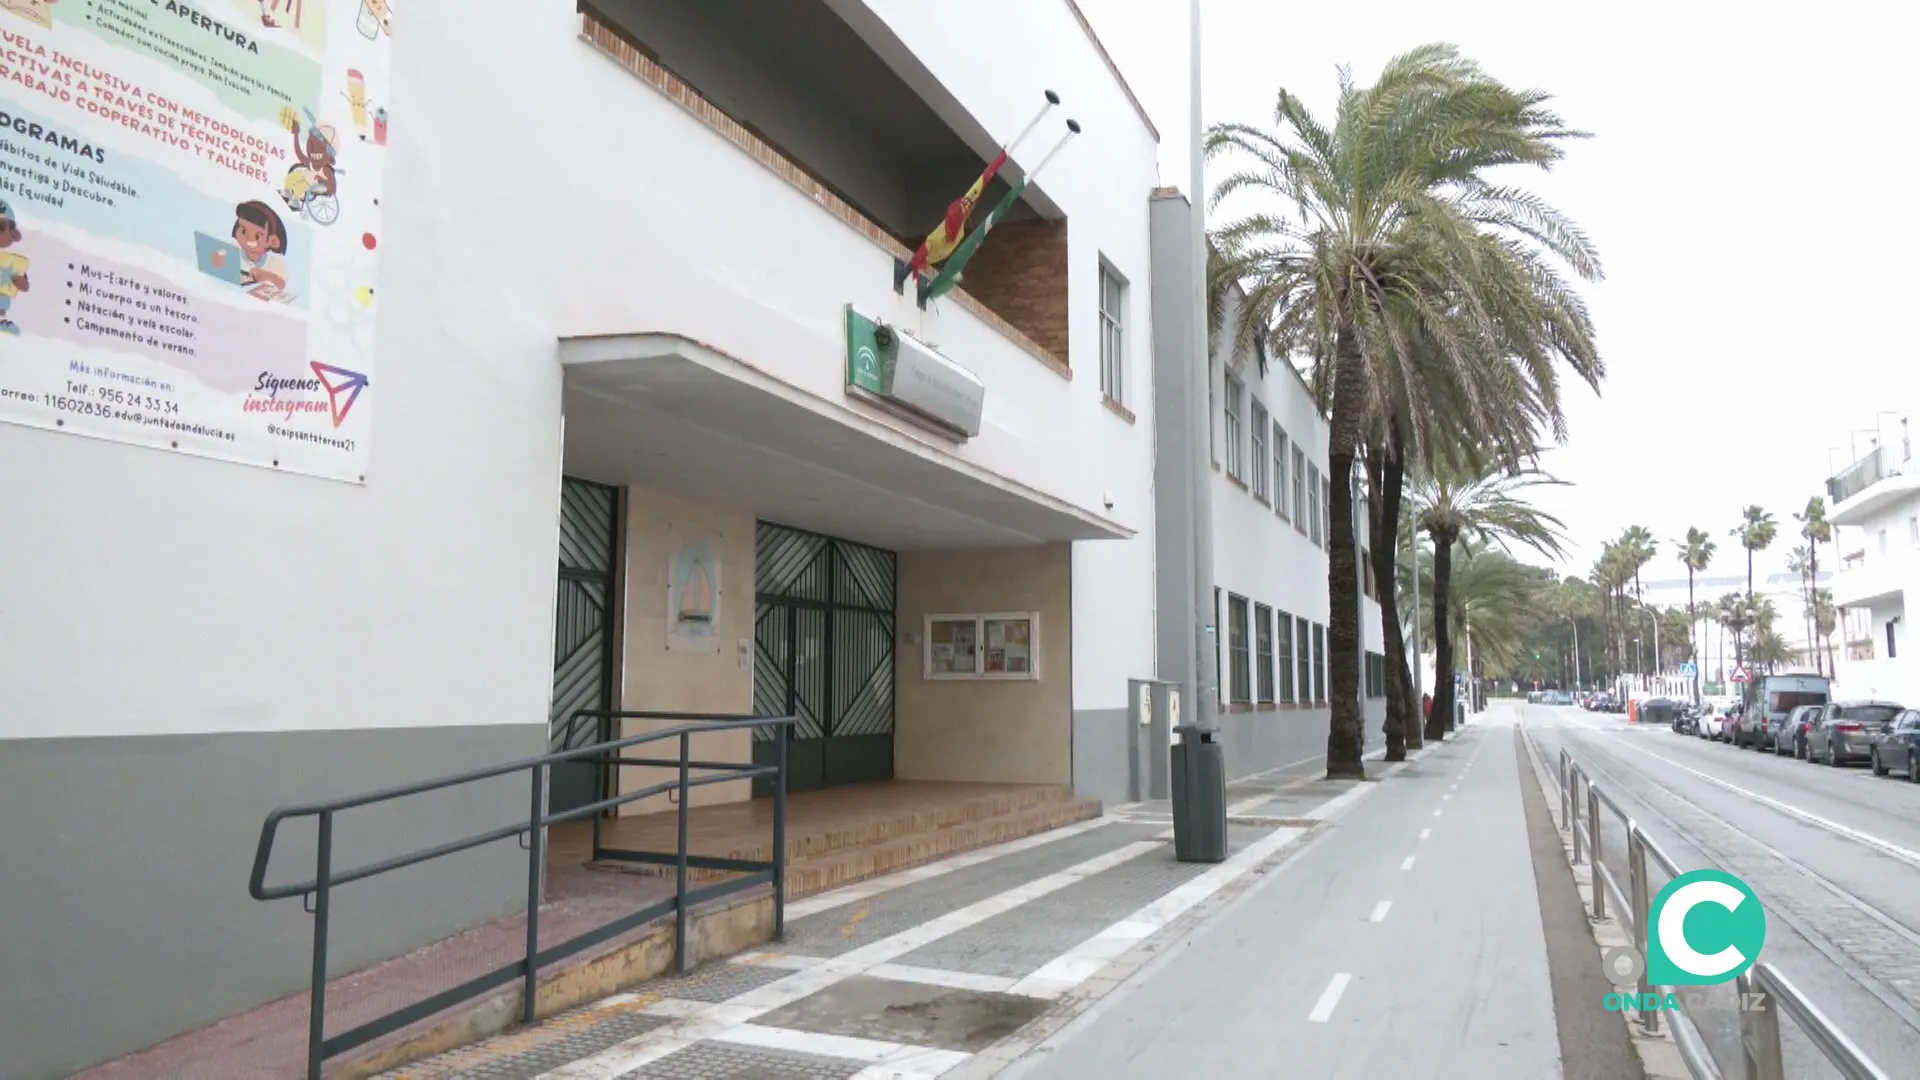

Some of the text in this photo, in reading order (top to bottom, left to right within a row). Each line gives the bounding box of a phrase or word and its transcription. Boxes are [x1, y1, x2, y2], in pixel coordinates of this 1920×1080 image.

[96, 17, 135, 40] Comedor
[137, 38, 152, 50] con
[165, 0, 258, 54] APERTURA
[52, 50, 142, 98] INCLUSIVA
[147, 92, 178, 114] CON
[77, 80, 88, 93] A
[158, 113, 175, 130] DE
[250, 152, 266, 167] DE
[76, 97, 189, 150] COOPERATIVO
[194, 143, 202, 157] Y
[207, 149, 271, 185] TALLERES.
[44, 156, 58, 169] de
[62, 161, 85, 179] Vida
[88, 171, 140, 199] Saludable.
[52, 179, 59, 190] y
[62, 179, 117, 208] Descubre.
[19, 183, 64, 208] Equidad
[79, 282, 200, 325] Mi cuerpo es un tesoro.
[144, 284, 150, 295] y
[152, 287, 190, 306] valores.
[77, 300, 198, 341] Natación y vela escolar.
[76, 317, 198, 358] Campamento de verano.
[69, 360, 175, 392] Más información en:
[254, 371, 320, 398] Síguenos
[99, 387, 124, 404] 956
[127, 393, 141, 408] 24
[145, 397, 161, 412] 33
[164, 400, 179, 415] 34
[243, 393, 329, 422] instagram
[267, 424, 355, 452] @ceipsantateresa21
